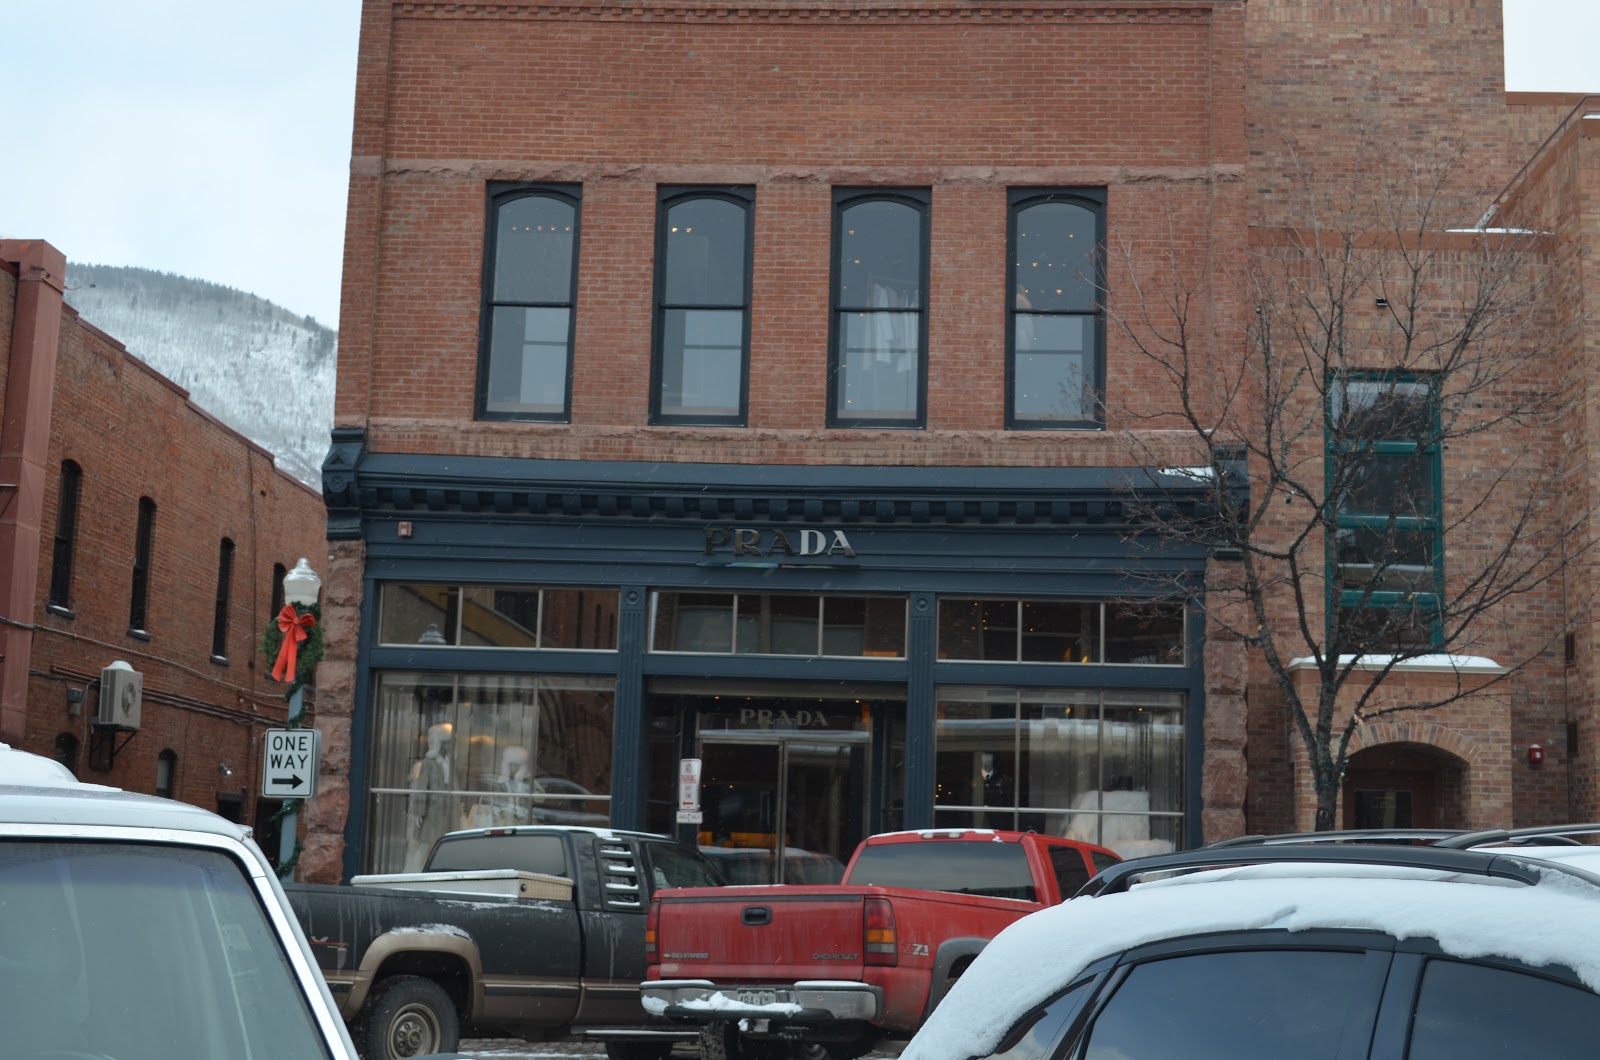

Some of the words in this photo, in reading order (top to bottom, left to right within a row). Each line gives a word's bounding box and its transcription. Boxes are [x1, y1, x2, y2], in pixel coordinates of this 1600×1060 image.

[704, 528, 856, 556] PRADA
[740, 708, 829, 727] PRADA
[272, 736, 308, 751] ONE
[270, 754, 308, 769] WAY
[679, 775, 697, 784] PARKING
[903, 943, 929, 957] Z71
